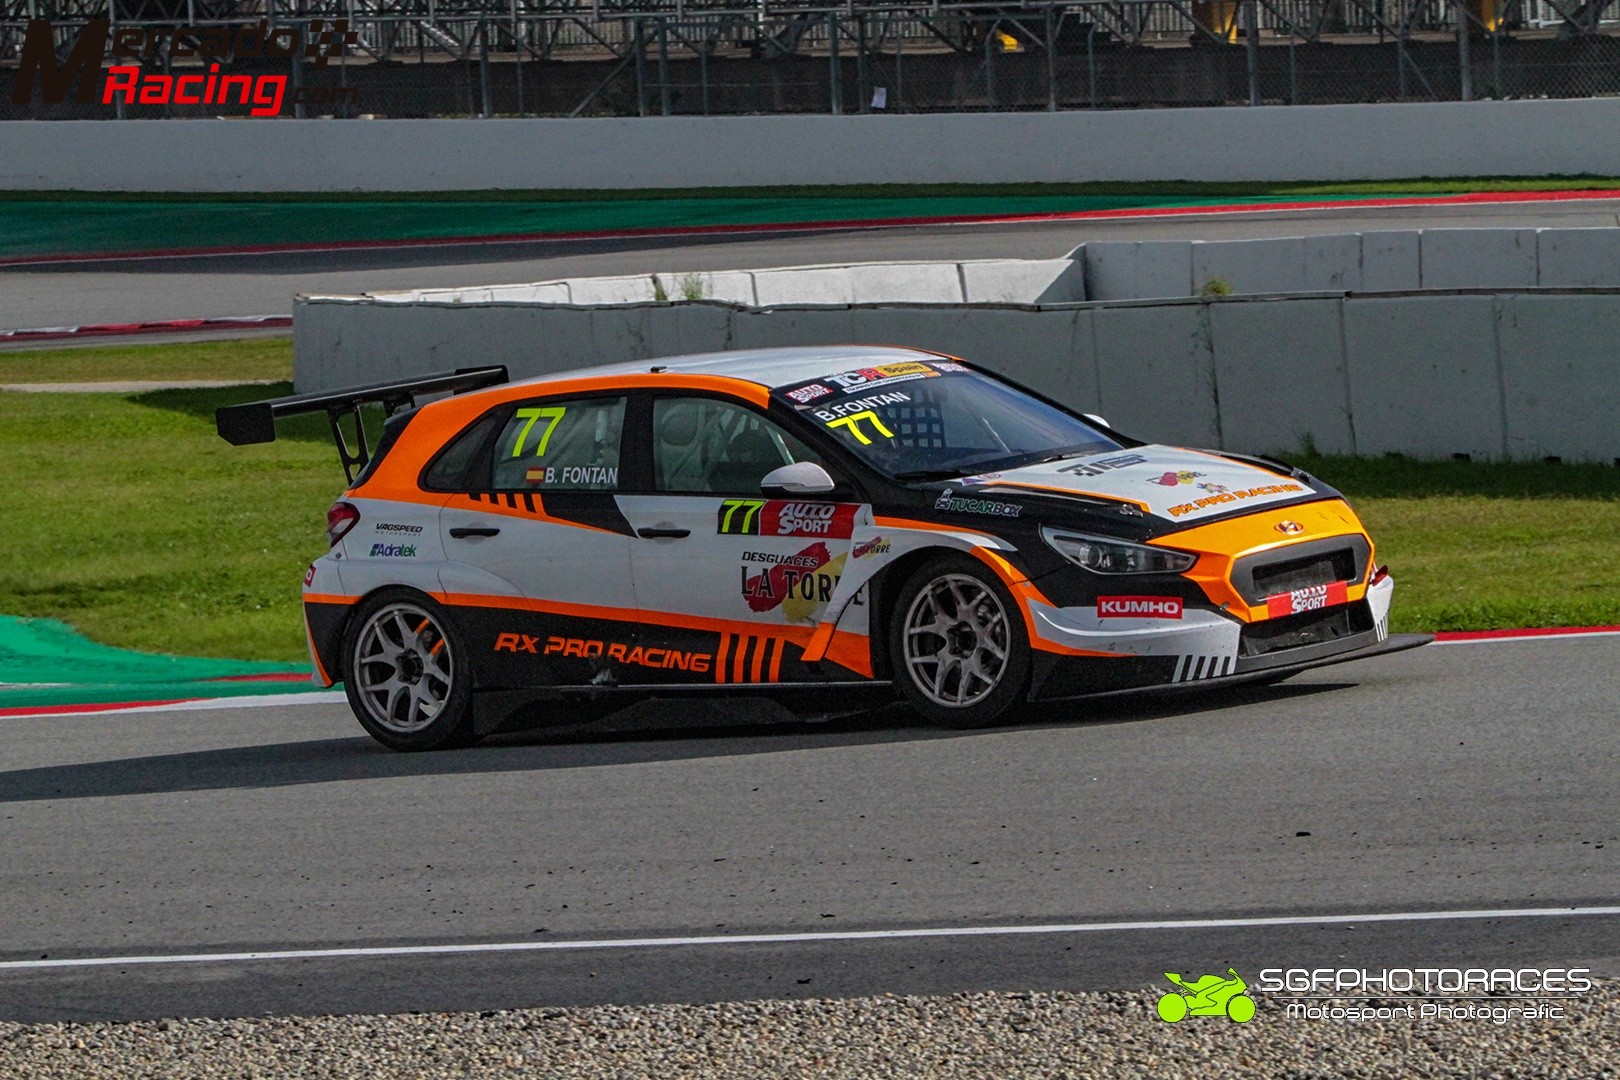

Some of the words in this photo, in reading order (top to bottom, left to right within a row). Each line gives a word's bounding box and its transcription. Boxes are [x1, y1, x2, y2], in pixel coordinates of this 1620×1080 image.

[824, 367, 887, 388] TCR
[883, 364, 924, 376] Spain
[789, 384, 822, 399] AUTO
[795, 387, 831, 403] SPORT
[512, 407, 566, 457] 77
[826, 410, 895, 445] 77
[545, 467, 558, 484] B.
[562, 467, 618, 484] FONTAN
[951, 497, 1023, 517] TUCARBOX
[1167, 503, 1199, 517] RX
[1193, 493, 1236, 508] PRO
[1232, 483, 1303, 499] RACING
[722, 500, 764, 533] 77
[778, 503, 836, 519] AUTO
[376, 523, 423, 533] VAGSPEED
[777, 514, 832, 535] SPORT
[376, 543, 417, 557] Adratek
[741, 551, 818, 568] DESGUACES
[741, 565, 775, 599] LA
[1101, 600, 1179, 615] KUMHO
[1290, 594, 1328, 615] SPORT
[494, 632, 540, 654] RX
[543, 636, 604, 658] PRO
[607, 642, 712, 673] RACING
